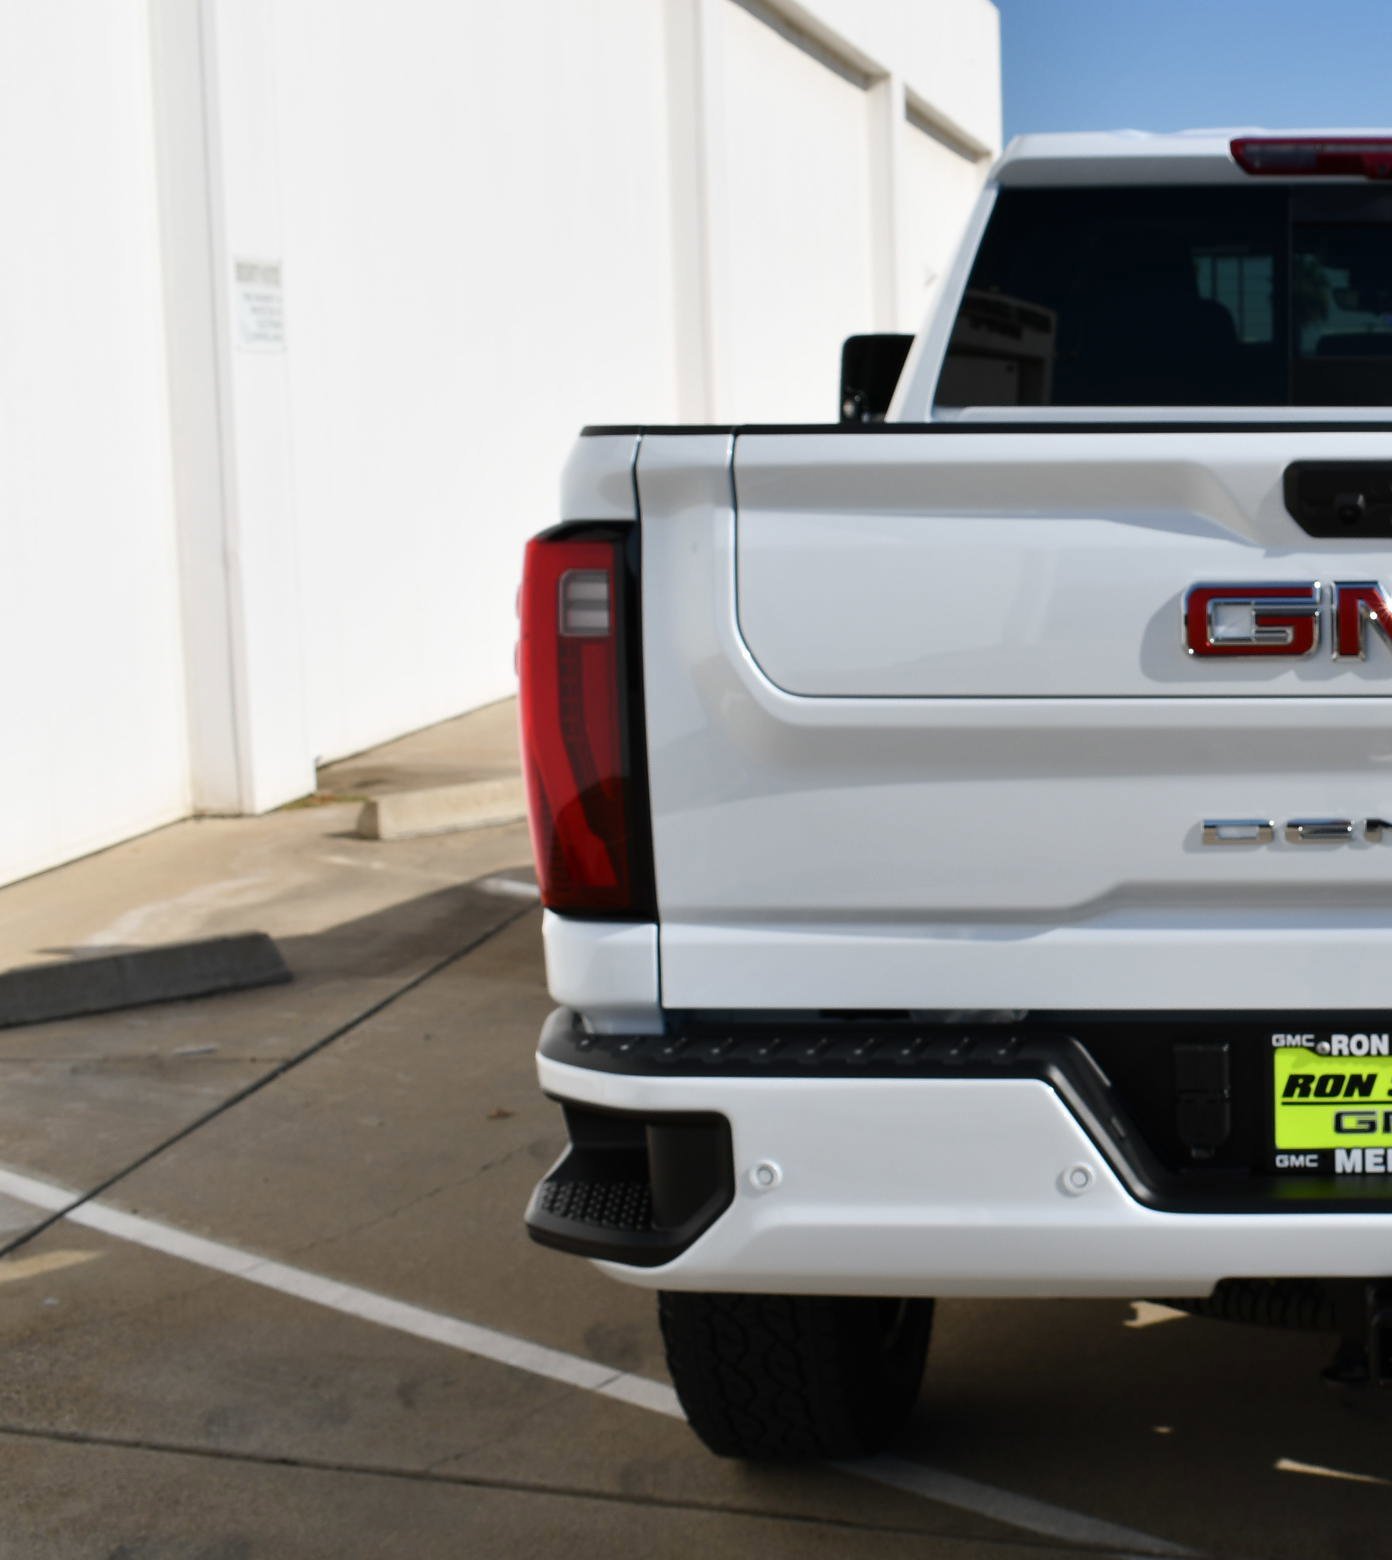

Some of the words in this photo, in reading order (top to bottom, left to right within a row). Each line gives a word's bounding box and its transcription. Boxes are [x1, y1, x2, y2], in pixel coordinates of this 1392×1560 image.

[1271, 1034, 1315, 1047] GMC
[1331, 1034, 1389, 1056] RON
[1282, 1074, 1377, 1098] RON
[1275, 1154, 1318, 1168] GMC
